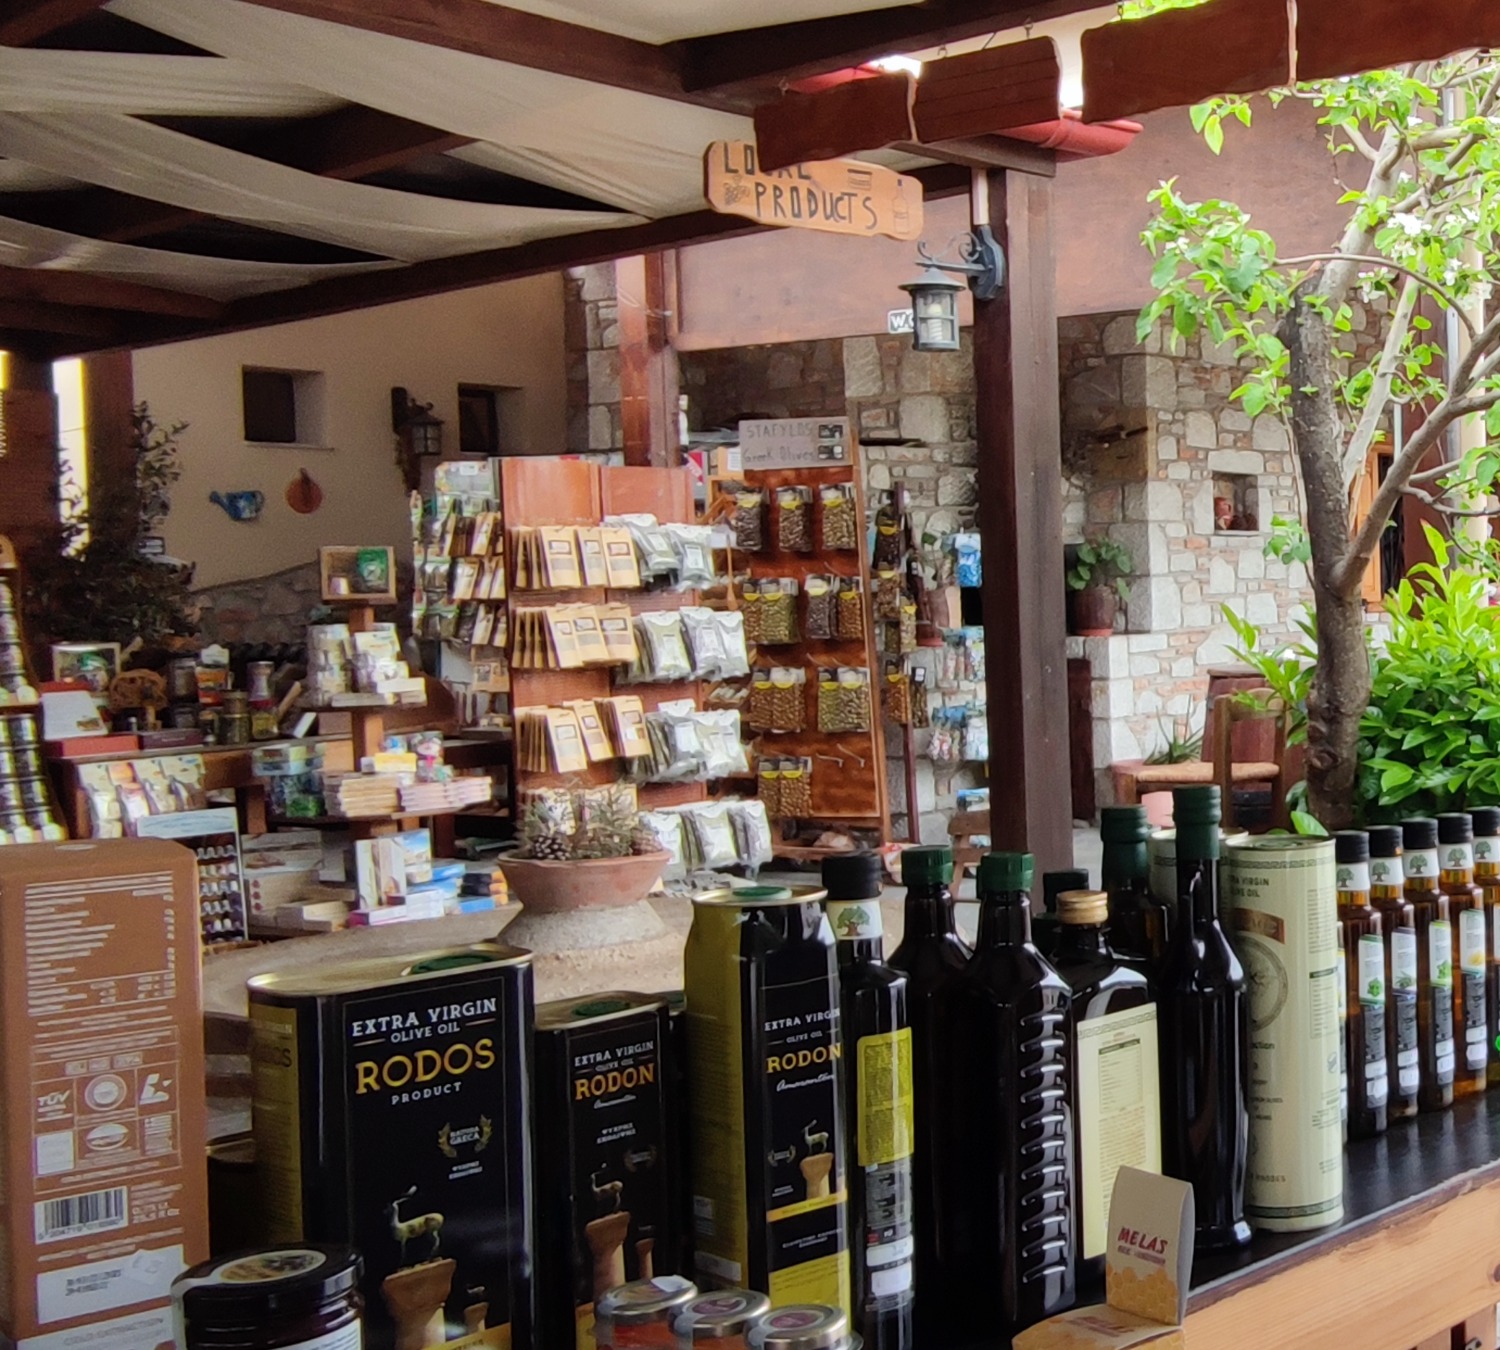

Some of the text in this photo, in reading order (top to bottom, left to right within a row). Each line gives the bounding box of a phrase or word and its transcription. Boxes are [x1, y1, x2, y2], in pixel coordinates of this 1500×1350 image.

[755, 181, 878, 230] PRODUCTS
[352, 998, 497, 1037] EXTRA VIRGIN
[391, 1021, 461, 1043] OLIVE OIL
[764, 1016, 801, 1032] EXTRA
[355, 1038, 496, 1095] RODOS
[574, 1040, 655, 1067] EXTRA VIRGIN
[765, 1042, 842, 1074] RODON
[391, 1081, 463, 1105] PRODUCT
[574, 1062, 656, 1100] RODON
[1117, 1225, 1168, 1254] MELAS
